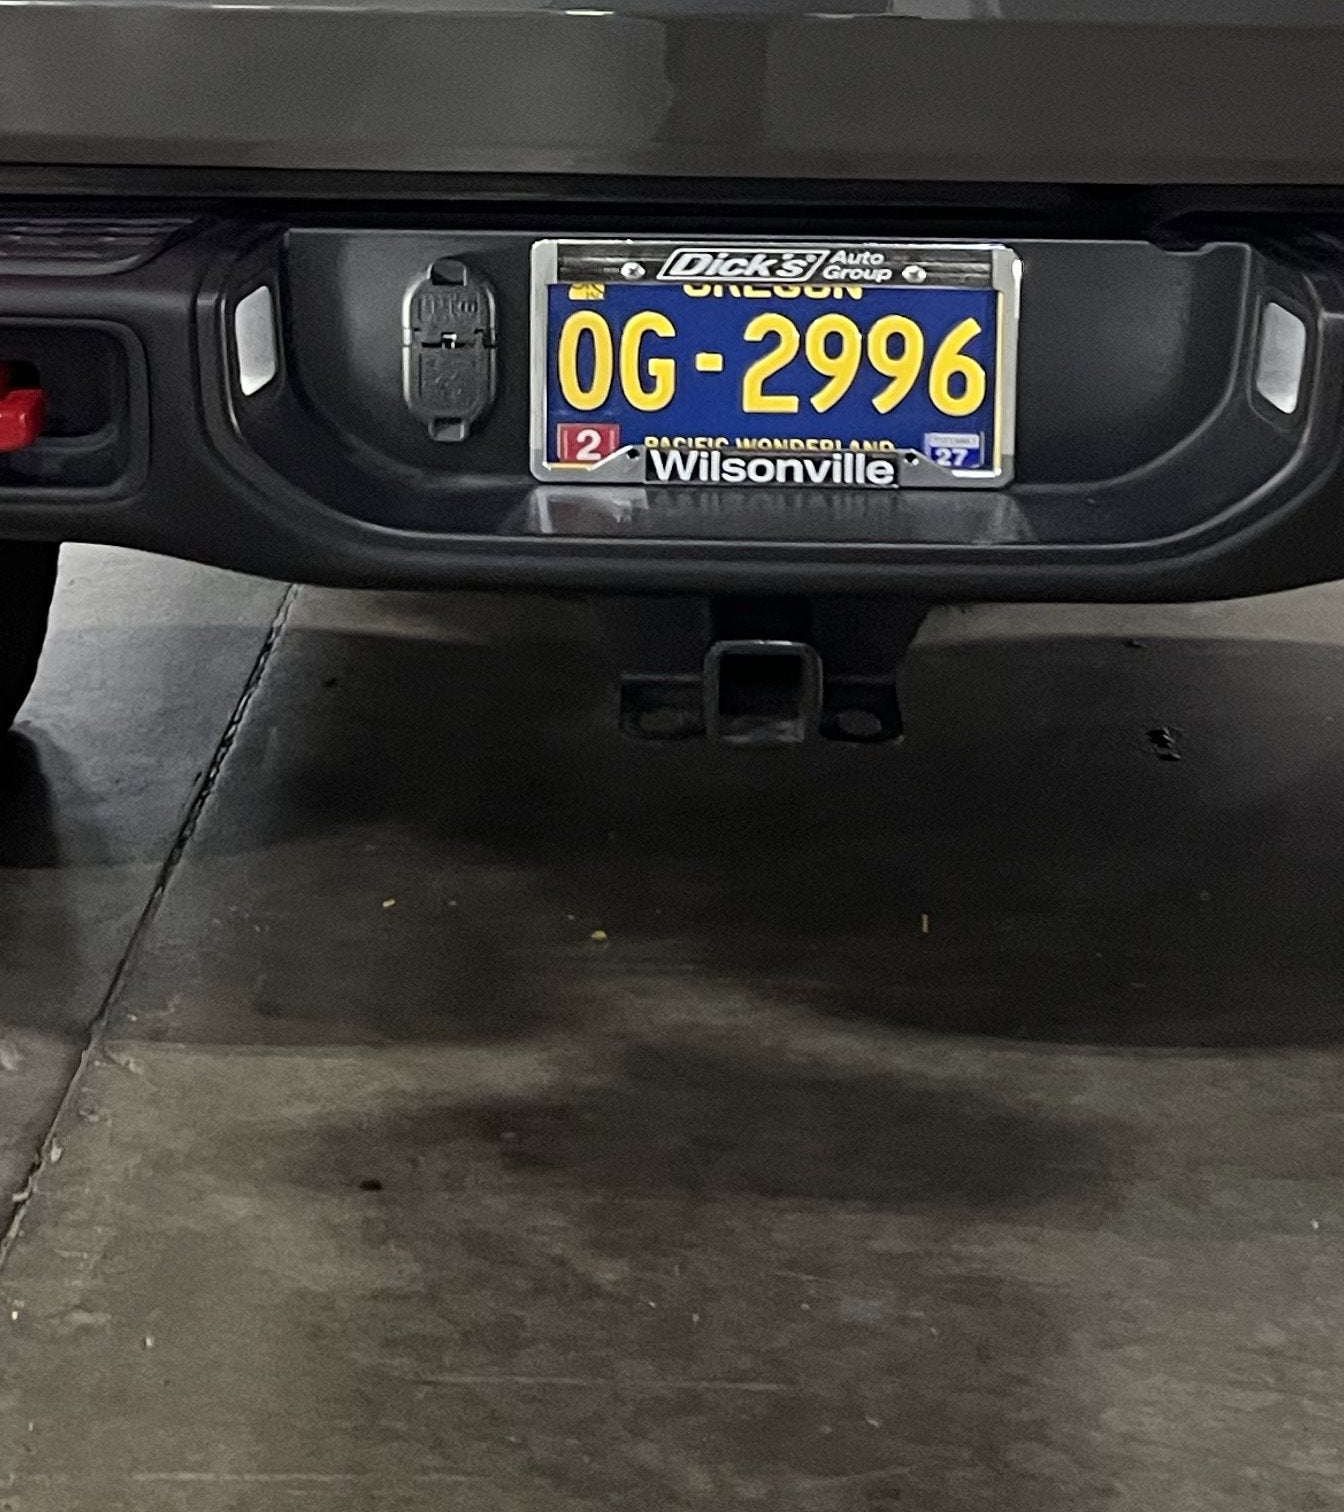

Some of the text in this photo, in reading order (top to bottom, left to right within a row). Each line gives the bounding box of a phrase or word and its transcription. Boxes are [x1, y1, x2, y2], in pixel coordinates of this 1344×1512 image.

[669, 252, 810, 279] Dick's
[828, 250, 884, 266] Auto
[822, 264, 893, 282] Group
[575, 429, 602, 461] 2
[649, 449, 895, 485] Wilsonville
[934, 447, 969, 467] 27
